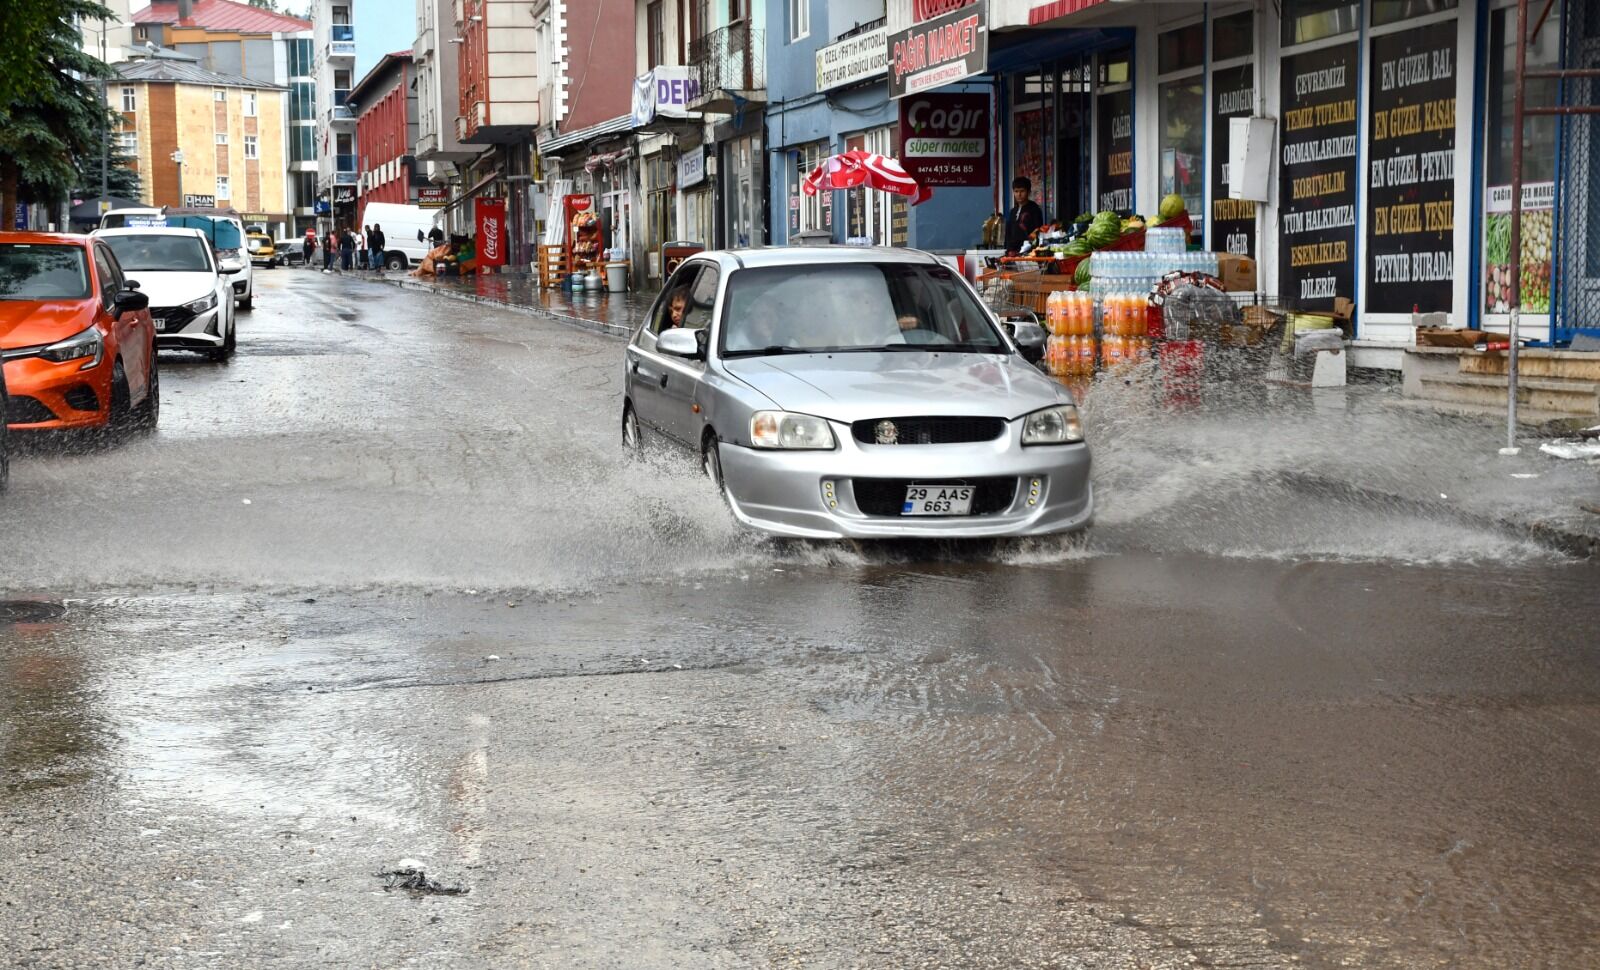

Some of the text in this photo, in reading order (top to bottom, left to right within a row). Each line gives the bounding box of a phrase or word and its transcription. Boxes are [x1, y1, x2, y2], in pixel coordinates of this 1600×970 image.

[859, 32, 886, 54] MOTORLU
[894, 30, 926, 84] ÇAĞIR
[928, 14, 979, 66] MARKET
[1295, 60, 1346, 101] ÇEVREMİZİ
[1382, 48, 1453, 91] EN GÜZEL BAL
[908, 100, 983, 136] Çağır
[1285, 100, 1356, 131] TEMİZ TUTALIM
[1375, 111, 1388, 140] EN
[1390, 98, 1421, 138] GÜZEL
[909, 140, 980, 154] süper market
[1283, 135, 1356, 165] ORMANLARIMIZI
[933, 164, 949, 174] 413
[951, 164, 961, 173] 54
[963, 164, 974, 173] 85
[1371, 159, 1384, 188] EN
[1387, 147, 1418, 185] GÜZEL
[194, 193, 214, 204] HAN
[1292, 171, 1346, 199] KORUYALIM
[1533, 185, 1554, 198] MARKE
[1214, 199, 1237, 221] UYGUN
[1284, 204, 1355, 234] TÜM HALKIMIZA
[1375, 207, 1388, 236] EN
[1390, 195, 1421, 234] GÜZEL
[1291, 237, 1348, 267] ESENLİKLER
[1374, 245, 1454, 283] PEYNİR BURADA
[1301, 271, 1337, 299] DİLERİZ
[908, 488, 970, 501] 29 AAS
[924, 501, 951, 512] 663
